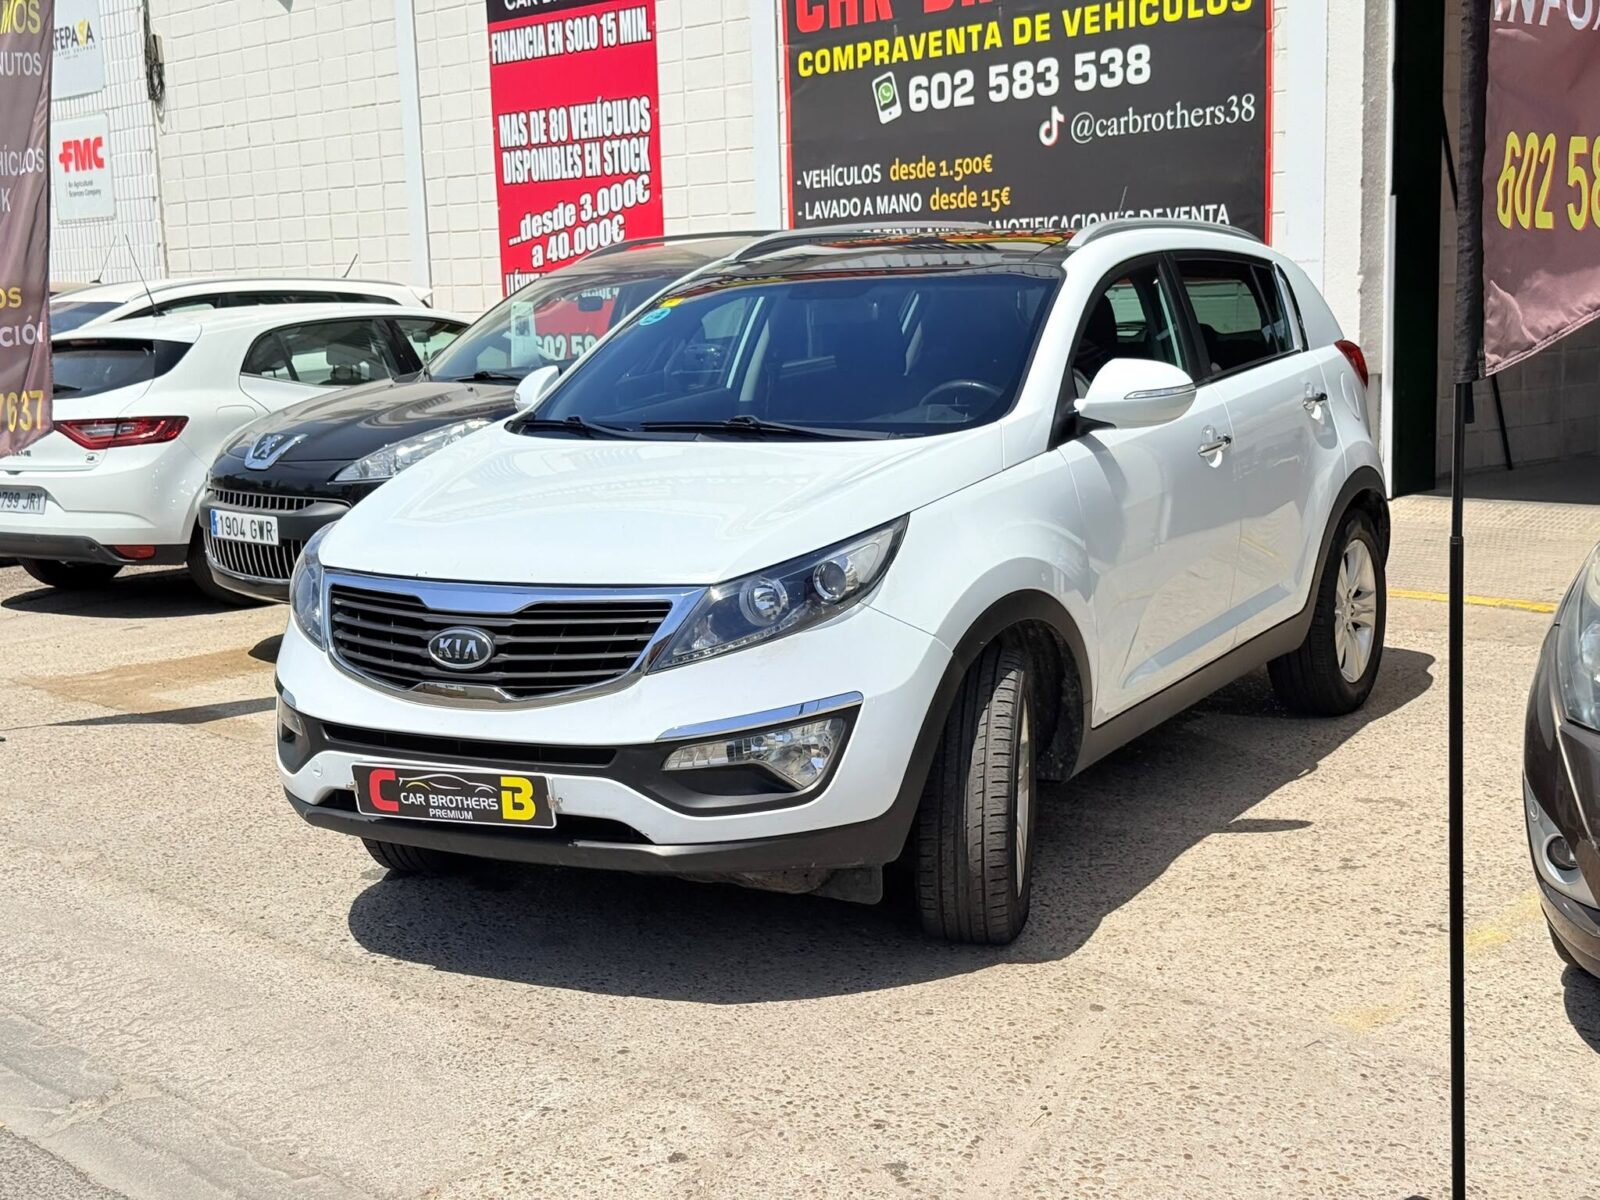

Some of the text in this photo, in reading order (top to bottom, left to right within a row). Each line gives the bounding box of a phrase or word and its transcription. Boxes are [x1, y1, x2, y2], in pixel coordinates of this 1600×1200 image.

[1493, 0, 1600, 31] INFO
[51, 20, 95, 51] FEPASA
[491, 6, 652, 65] FINANCIA EN SOLO 15 MIN.
[798, 21, 1003, 78] COMPRAVENTA
[1012, 13, 1051, 46] DE
[908, 44, 1151, 112] 602 583 538
[498, 96, 652, 148] MAS DE 80 VEHÍCULOS
[1070, 93, 1256, 144] @carbrothers38
[59, 136, 105, 173] FMC
[502, 137, 651, 185] DISPONIBLES EN STOCK
[803, 154, 993, 190] VEHÍCULOS desde 1.500€
[579, 173, 651, 223] 3.000€
[1496, 131, 1556, 230] 602
[805, 185, 1011, 221] LAVADO A MANO desde 15€
[531, 214, 625, 268] a 40.000€
[0, 491, 21, 509] 799
[220, 515, 274, 541] 1904 GWR
[439, 637, 480, 660] KIA
[400, 792, 426, 806] CAR
[429, 794, 499, 810] BROTHERS
[429, 808, 473, 820] PREMIUM
